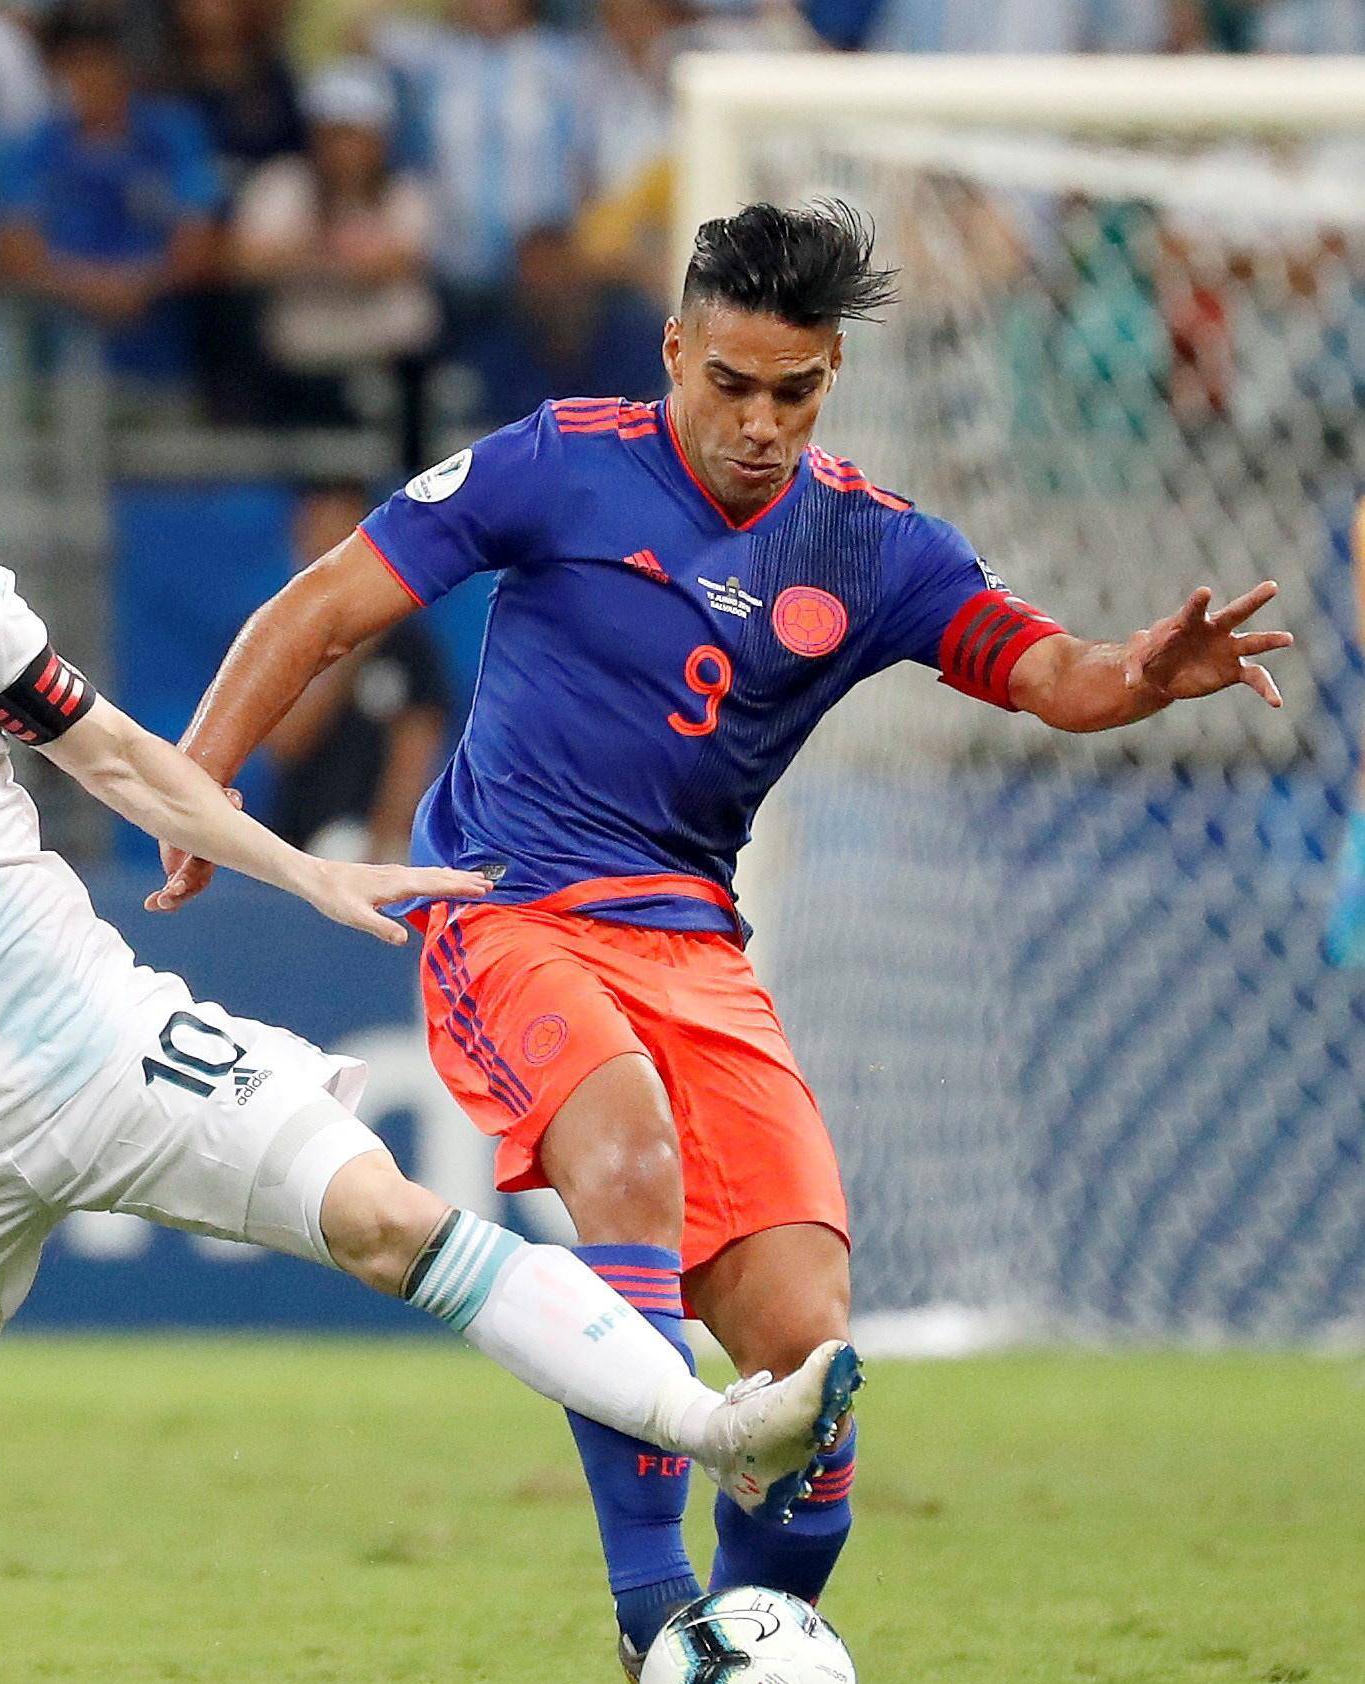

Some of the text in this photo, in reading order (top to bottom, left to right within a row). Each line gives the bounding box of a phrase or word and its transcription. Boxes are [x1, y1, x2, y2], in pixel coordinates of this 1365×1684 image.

[666, 644, 732, 737] 9
[142, 1010, 247, 1098] 10
[237, 1068, 273, 1106] adidas
